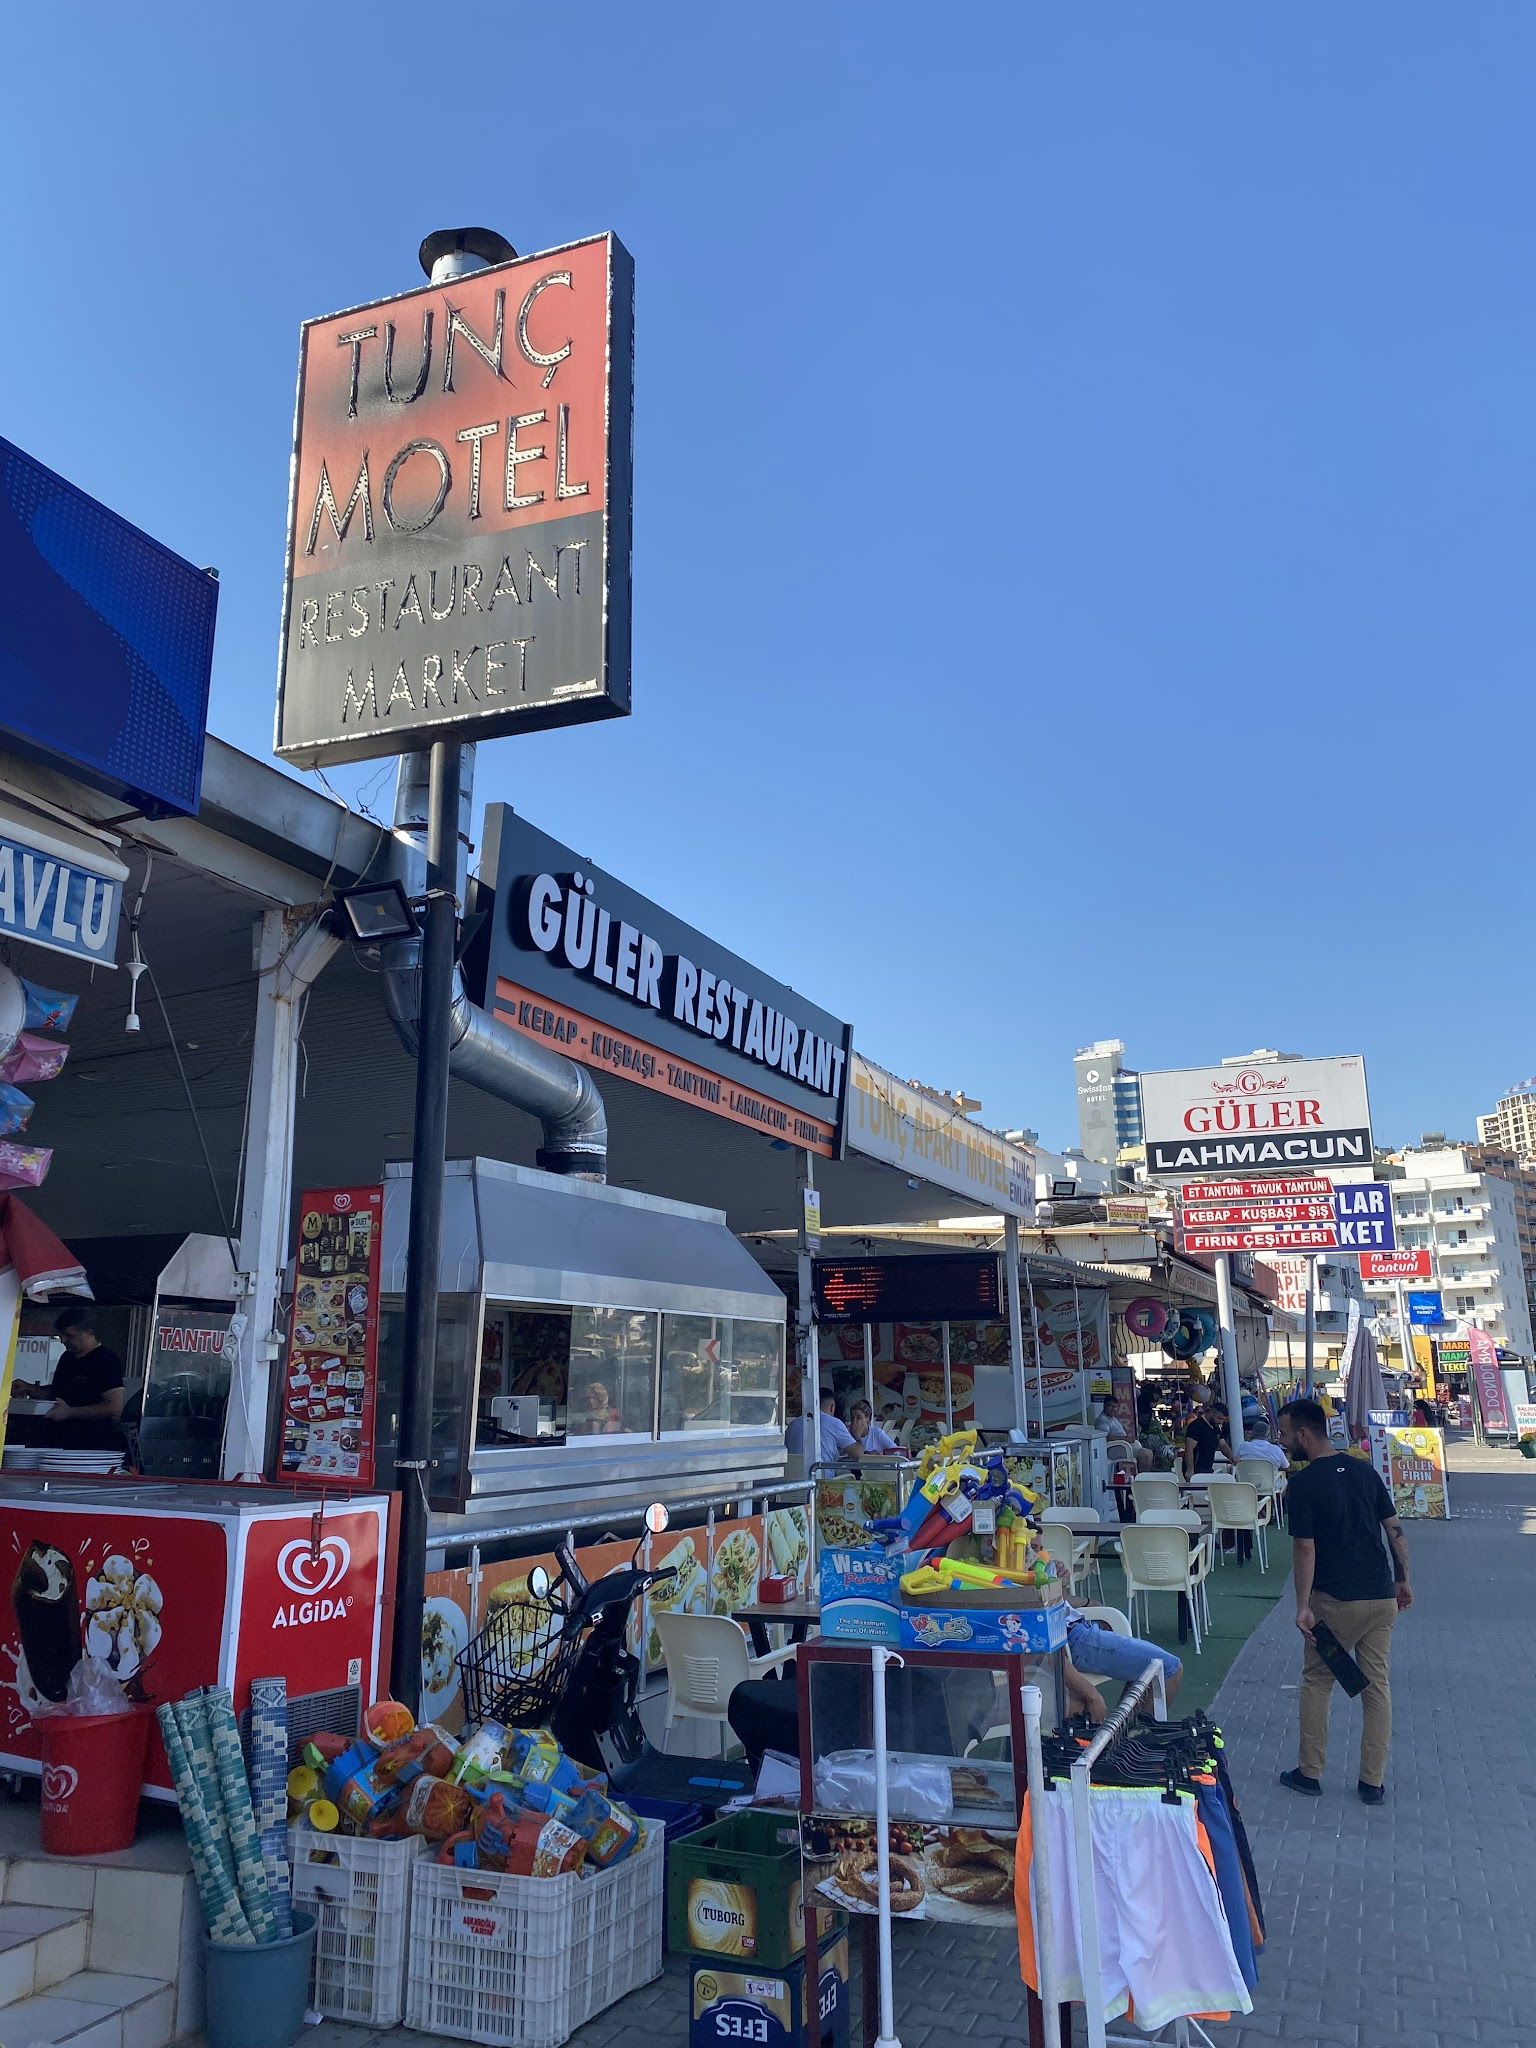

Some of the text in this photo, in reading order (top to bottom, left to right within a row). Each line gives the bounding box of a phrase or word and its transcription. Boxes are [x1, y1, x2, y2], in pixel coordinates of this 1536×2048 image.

[337, 270, 573, 419] TUNÇ
[306, 404, 589, 555] MOTEL
[300, 539, 590, 649] RESTAURANT
[342, 635, 536, 723] MARKET
[528, 870, 845, 1098] GÜLER RESTAURANT
[518, 1000, 578, 1045] KEBAP
[591, 1031, 656, 1079] KUŞBAŞI
[730, 1090, 788, 1132] LAHMACUN
[794, 1118, 818, 1144] FIRIN
[1086, 1095, 1107, 1103] HOTEL
[1184, 1100, 1324, 1133] GÜLER
[855, 1073, 1009, 1194] TUNÇ APART MOTEL
[1155, 1136, 1364, 1168] LAHMACUN
[1011, 1156, 1031, 1189] TUNÇ
[1009, 1181, 1032, 1211] EMLAK
[1188, 1187, 1199, 1198] ET
[1251, 1184, 1282, 1195] TAVUK
[1189, 1211, 1230, 1222] KEBAP
[1241, 1208, 1297, 1221] KUŞBAŞI
[1194, 1235, 1238, 1247] FIRIN
[1371, 1251, 1418, 1262] mmoş
[1371, 1412, 1405, 1425] DOSTLAR
[1402, 1471, 1432, 1481] FIRIN
[835, 1626, 858, 1634] Power
[869, 1628, 889, 1636] Water
[853, 1618, 886, 1627] Maximum
[702, 1908, 745, 1926] TUBORG
[715, 2013, 768, 2043] EFES
